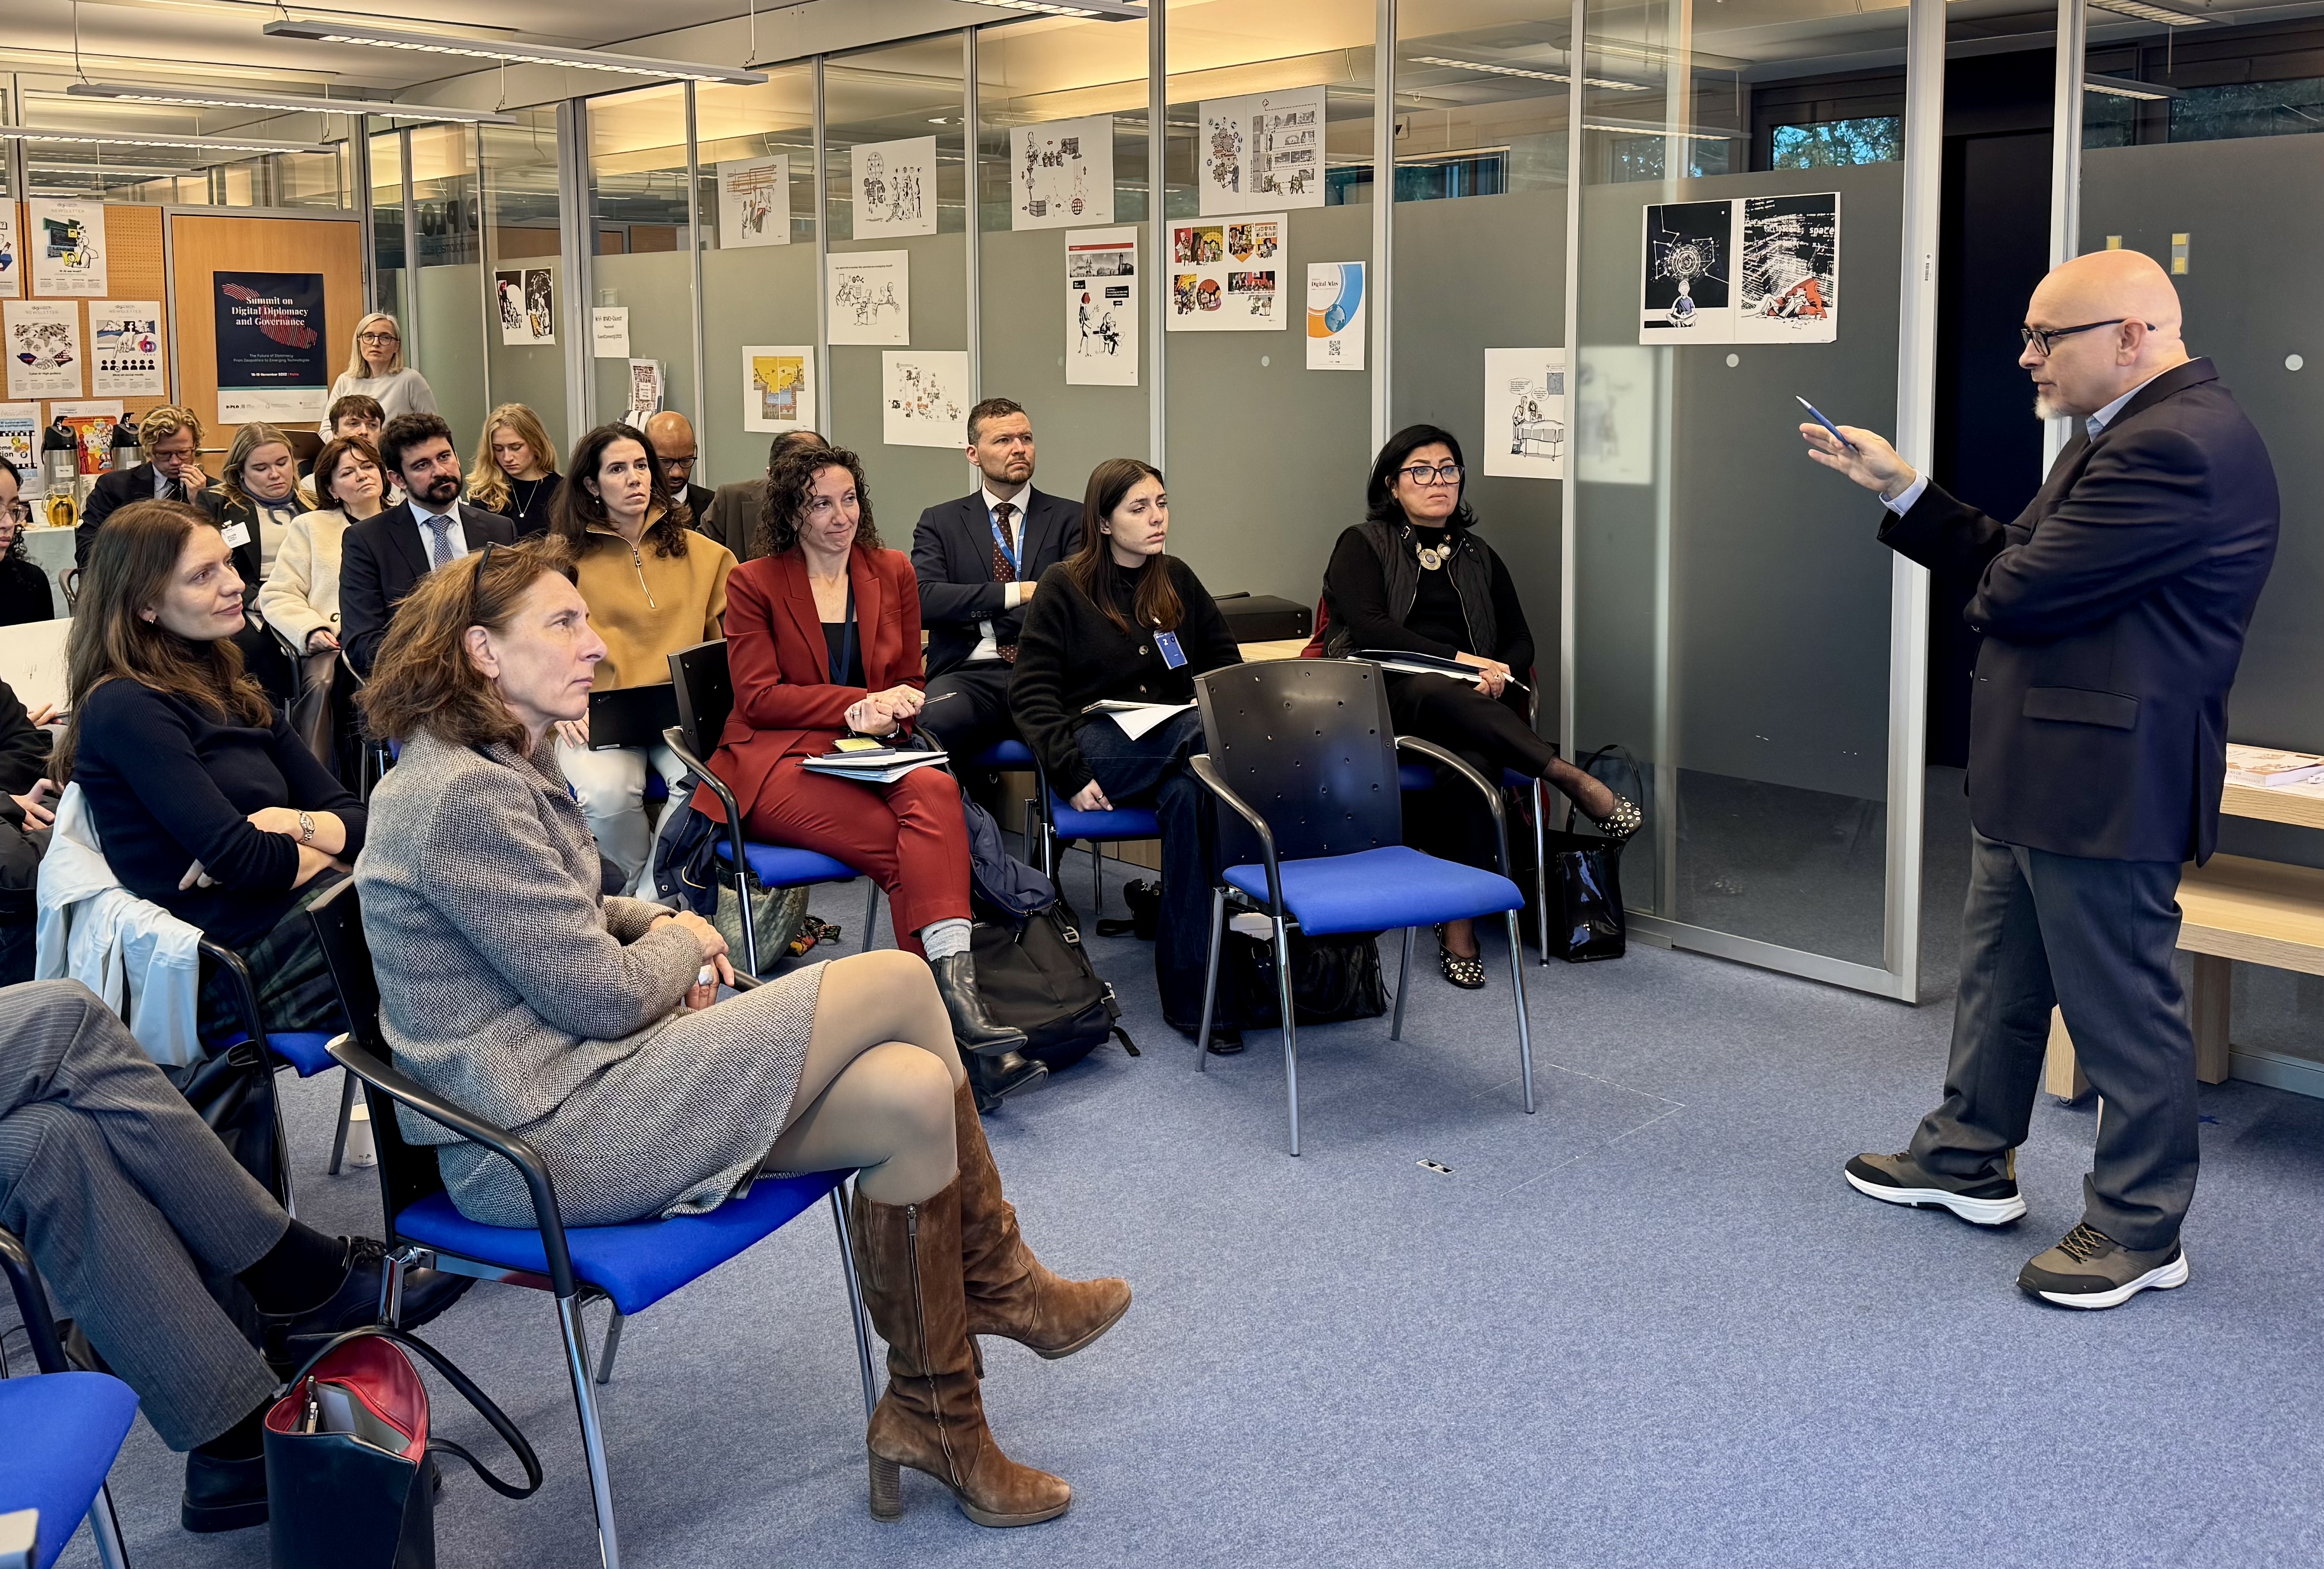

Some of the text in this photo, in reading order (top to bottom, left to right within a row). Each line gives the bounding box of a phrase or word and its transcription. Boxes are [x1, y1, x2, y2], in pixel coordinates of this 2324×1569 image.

[246, 296, 280, 305] Summit
[231, 306, 308, 317] Digital Diplomacy
[236, 317, 305, 326] and Governance
